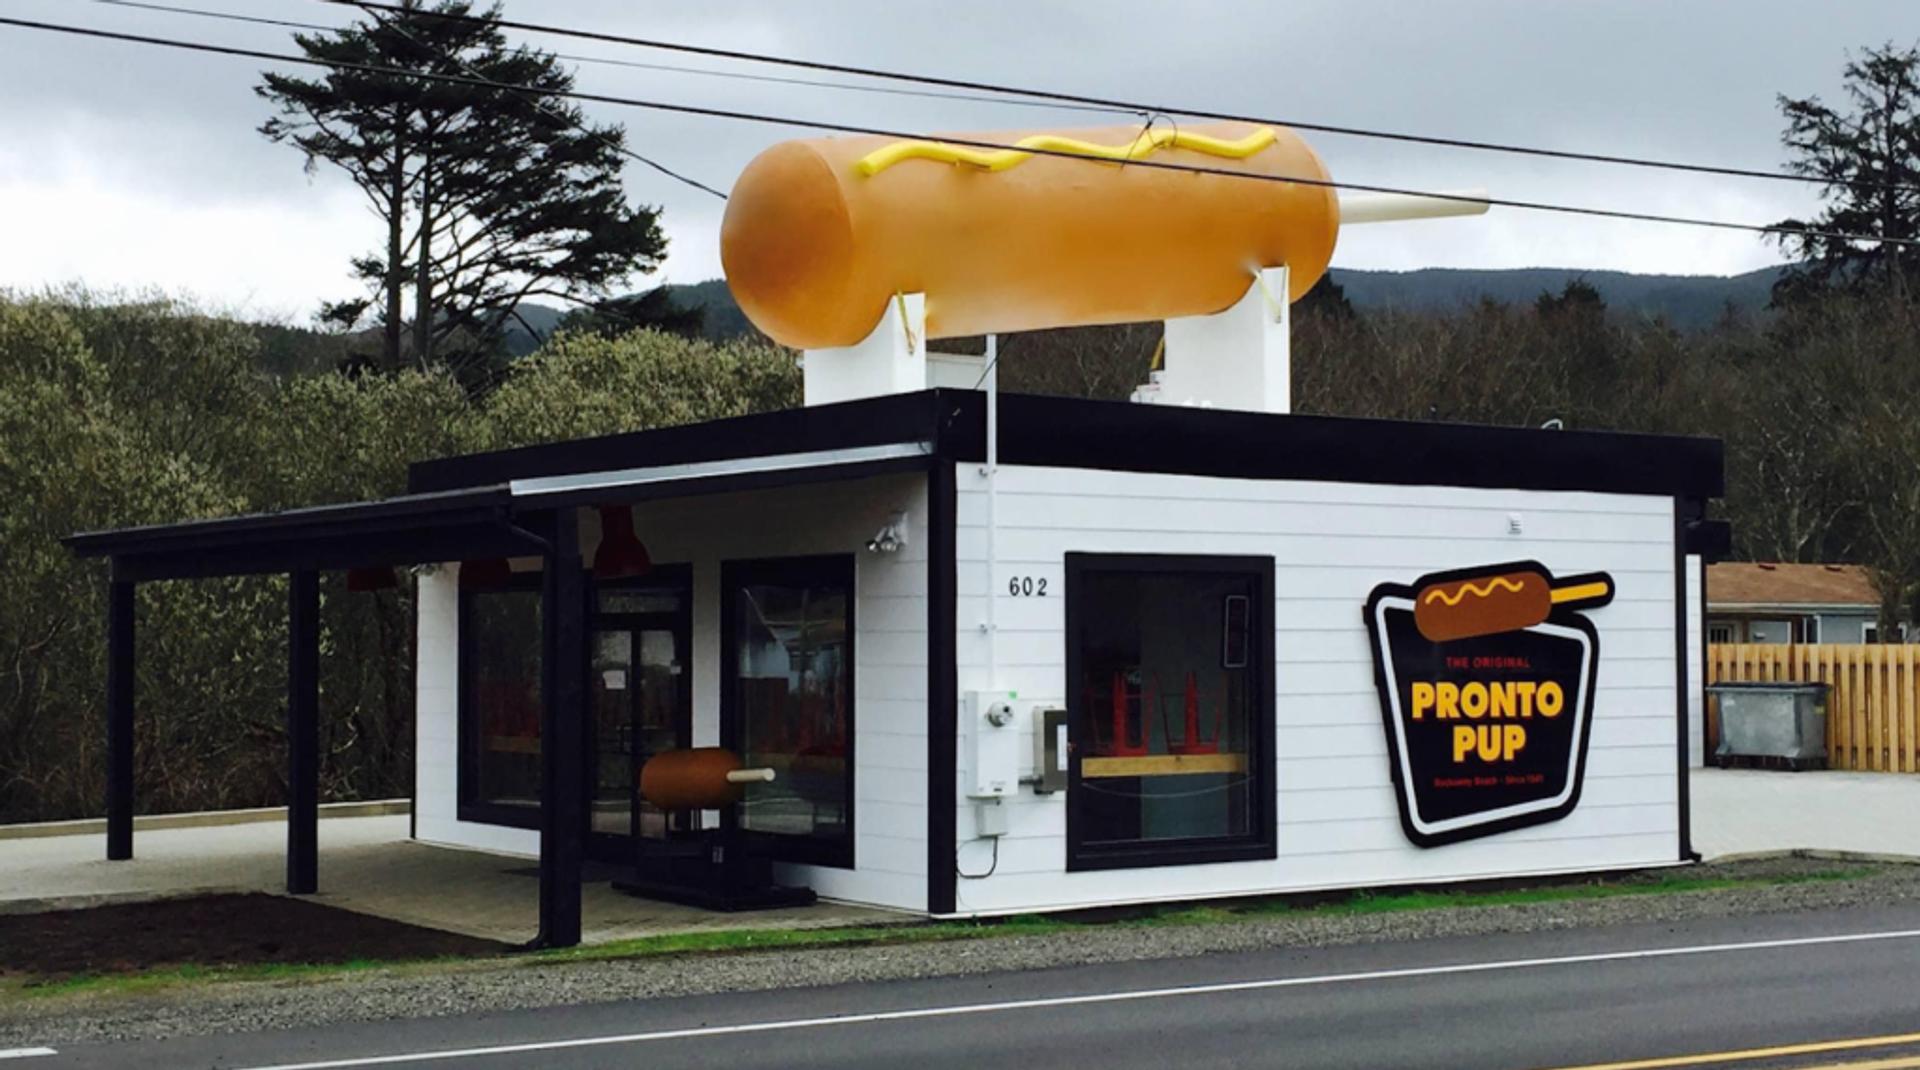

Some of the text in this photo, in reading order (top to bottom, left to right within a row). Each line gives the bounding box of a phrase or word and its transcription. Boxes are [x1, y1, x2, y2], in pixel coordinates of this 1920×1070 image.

[1009, 576, 1047, 596] 602
[1446, 656, 1530, 668] THE ORIGINAL
[1411, 681, 1563, 718] PRONTO
[1453, 725, 1526, 762] PUP
